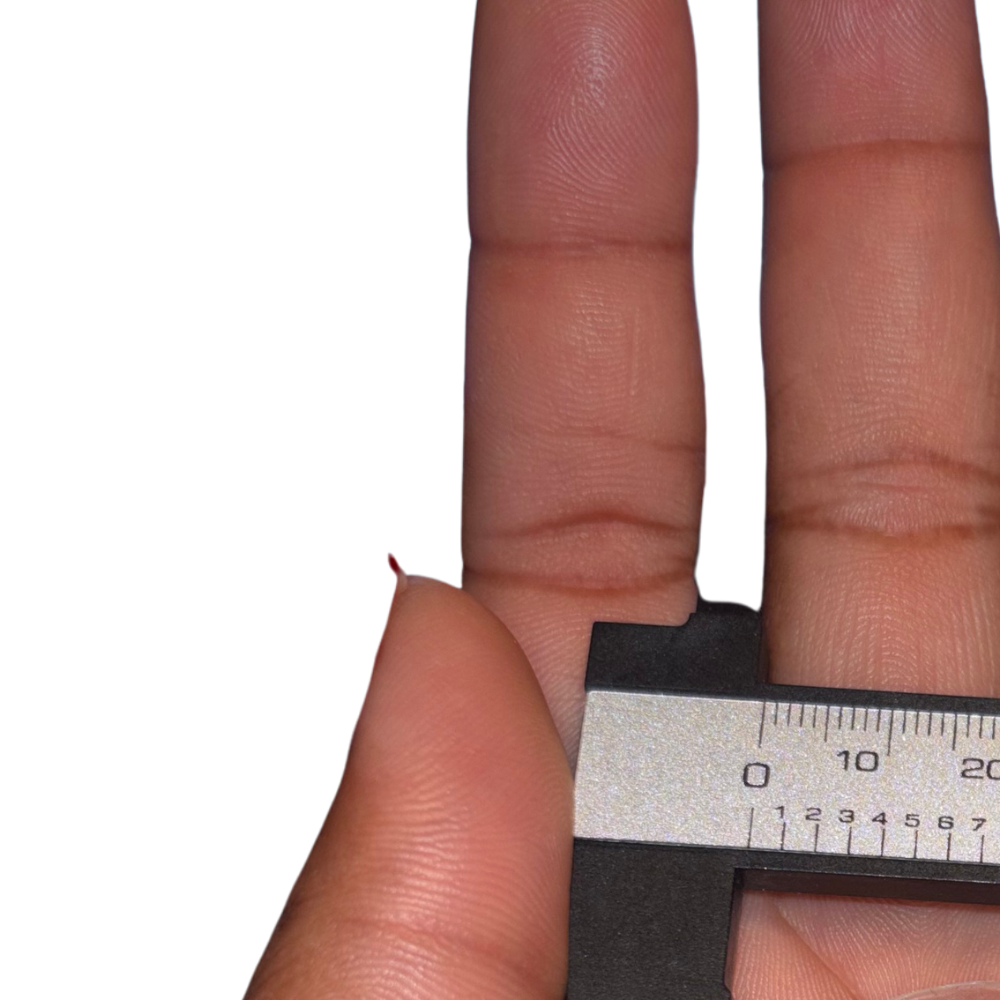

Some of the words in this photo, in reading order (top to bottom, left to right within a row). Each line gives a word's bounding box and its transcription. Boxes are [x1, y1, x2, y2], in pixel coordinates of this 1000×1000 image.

[742, 762, 771, 789] 0
[837, 750, 879, 772] 10
[775, 805, 785, 819] 1
[805, 807, 822, 822] 2
[838, 809, 855, 824] 3
[871, 811, 888, 826] 4
[904, 813, 921, 828] 5
[937, 815, 954, 830] 6
[971, 817, 987, 832] 7
